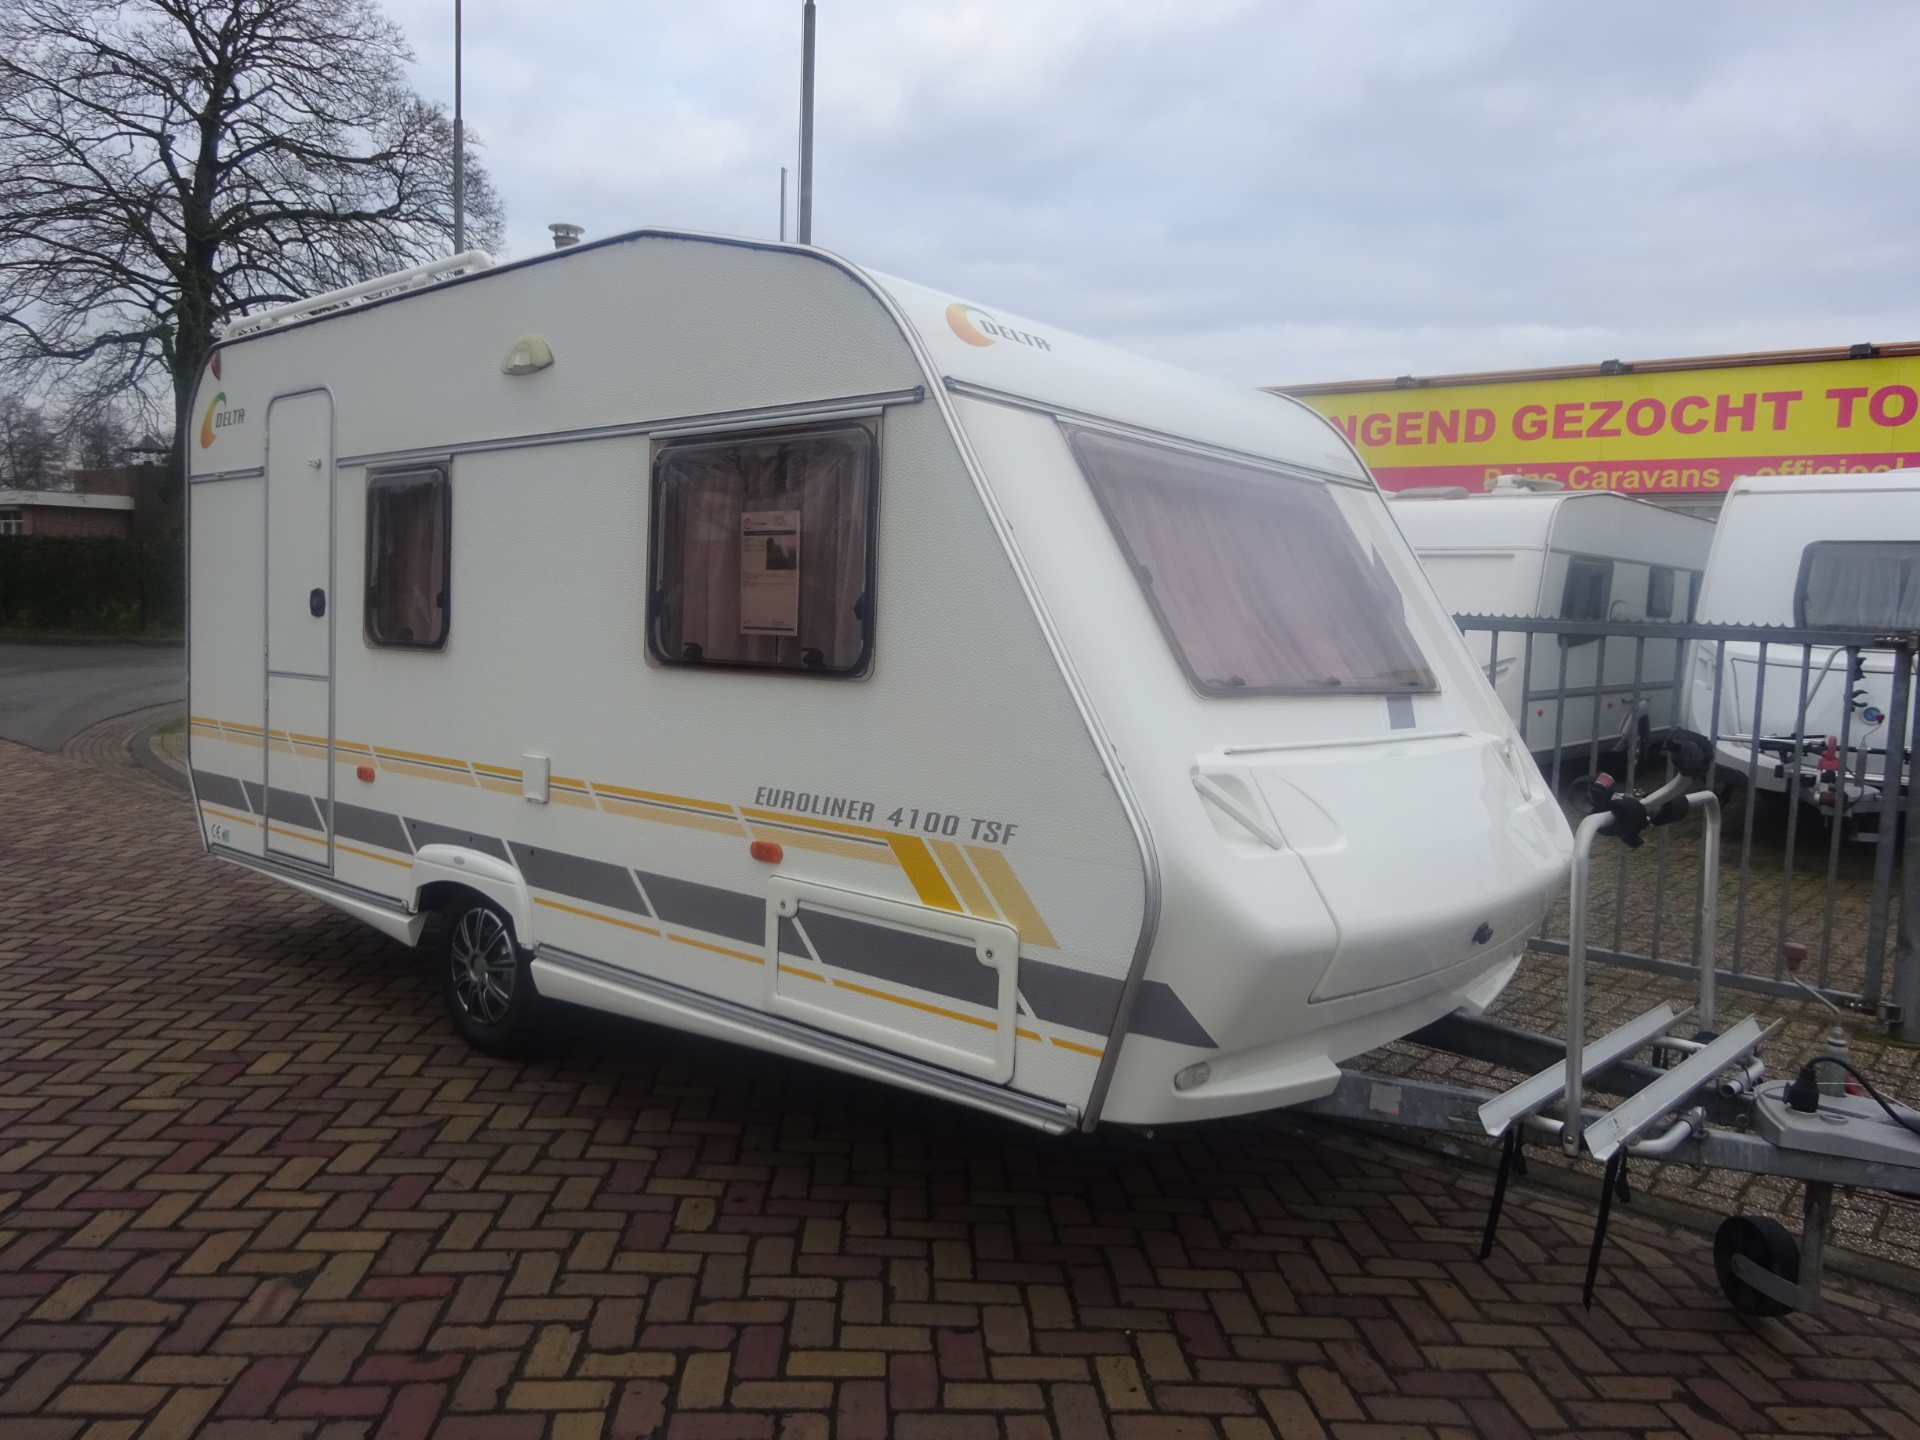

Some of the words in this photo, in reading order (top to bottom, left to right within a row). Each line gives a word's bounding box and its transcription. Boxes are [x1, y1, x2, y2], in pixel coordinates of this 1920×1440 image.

[979, 319, 1051, 352] DELTA
[215, 408, 246, 428] DELTA
[1511, 390, 1804, 441] GEZOCHT
[1824, 384, 1919, 428] TO
[1568, 465, 1721, 490] Caravans
[754, 786, 876, 823] EUROLINER
[886, 806, 960, 837] 4100
[970, 817, 1019, 846] TSF
